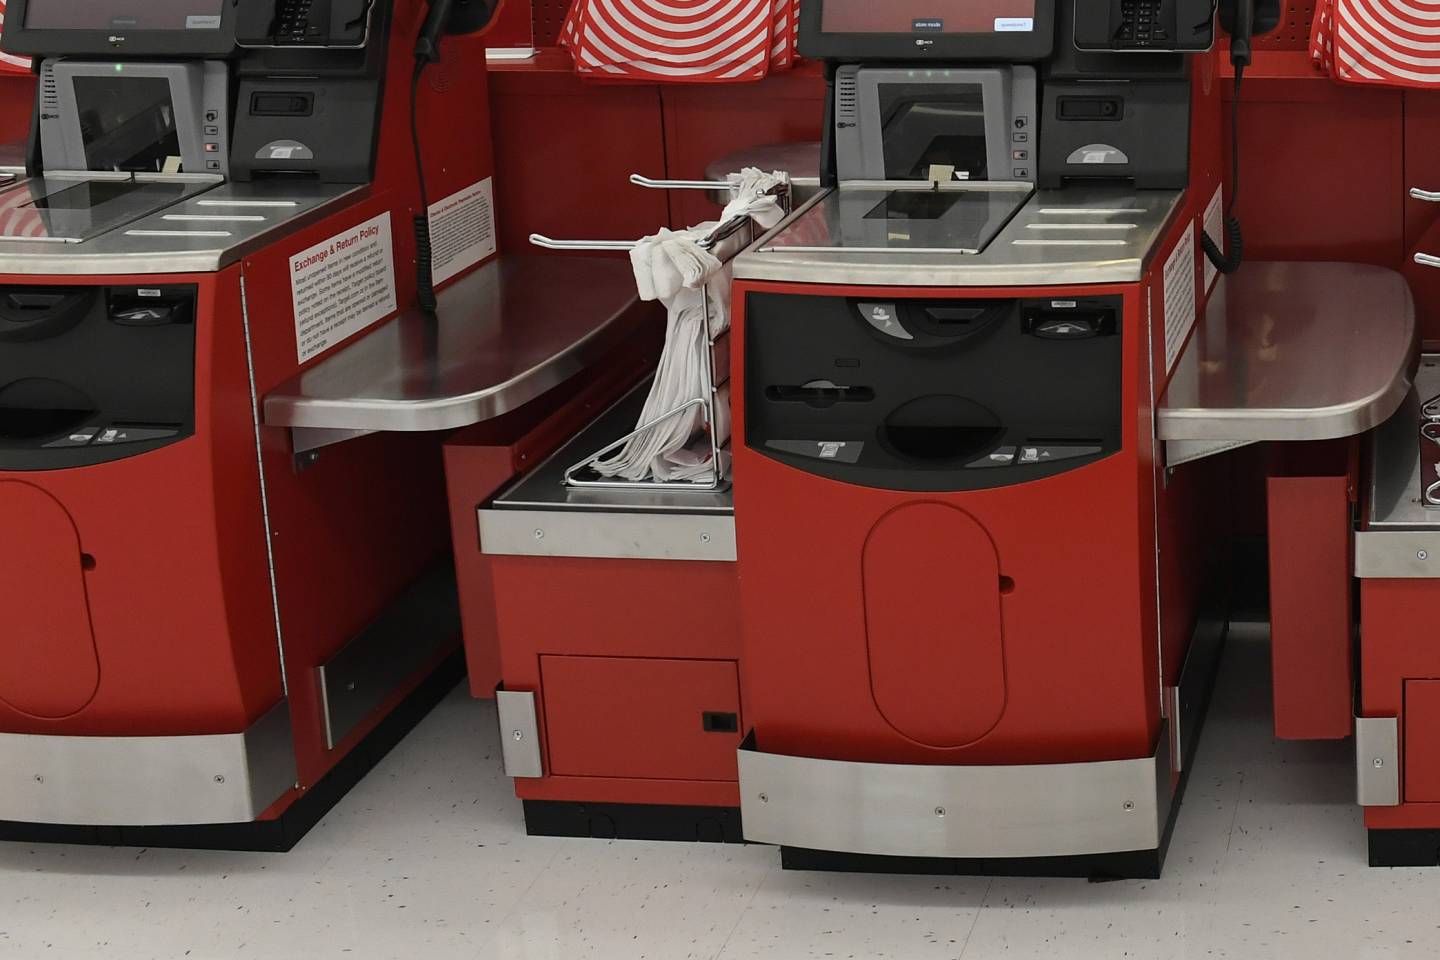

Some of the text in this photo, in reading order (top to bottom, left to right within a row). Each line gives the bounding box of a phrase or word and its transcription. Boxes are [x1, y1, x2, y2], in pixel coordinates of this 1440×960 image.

[295, 225, 380, 272] Exchange & Return Policy
